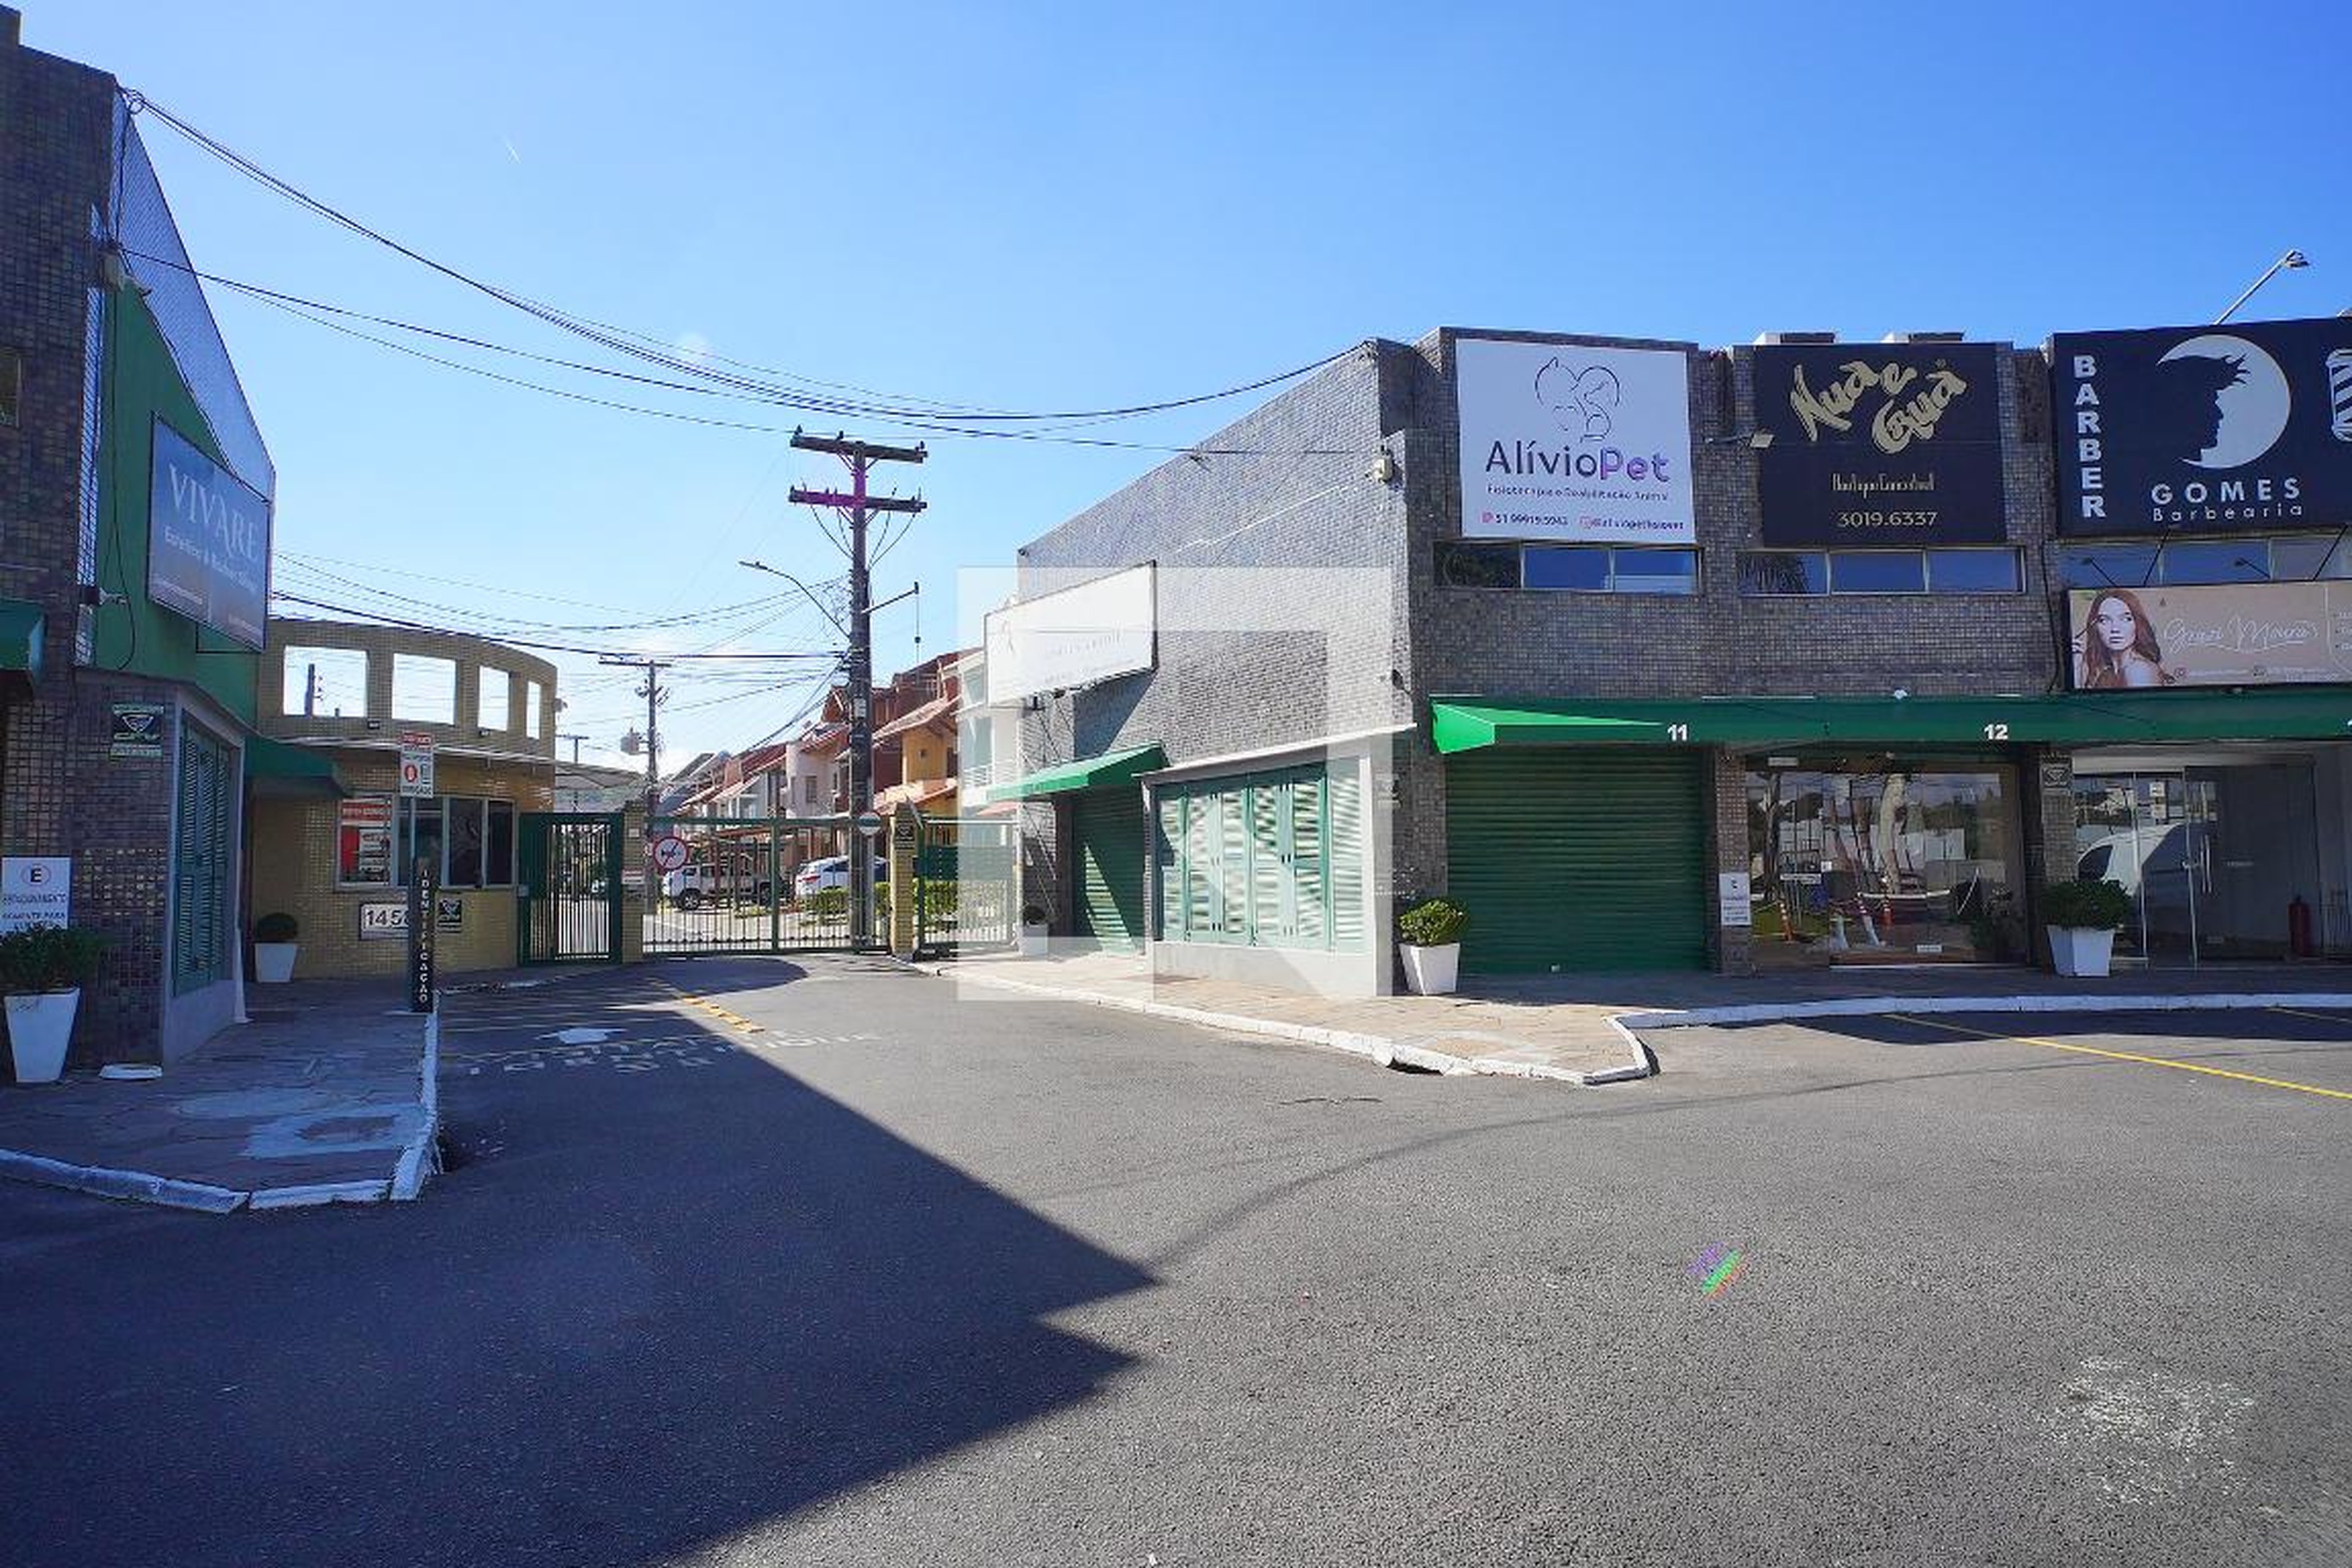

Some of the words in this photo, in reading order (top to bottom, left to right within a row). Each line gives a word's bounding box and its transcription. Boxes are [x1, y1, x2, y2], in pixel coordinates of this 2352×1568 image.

[2074, 355, 2106, 518] BARBER
[1485, 440, 1670, 483] AlívioPet
[2150, 477, 2301, 505] GOMES
[169, 463, 260, 562] VIVARE
[2153, 503, 2302, 522] Barbearia
[1667, 723, 1687, 741] 11
[1984, 723, 2008, 740] 12
[31, 868, 42, 883] E
